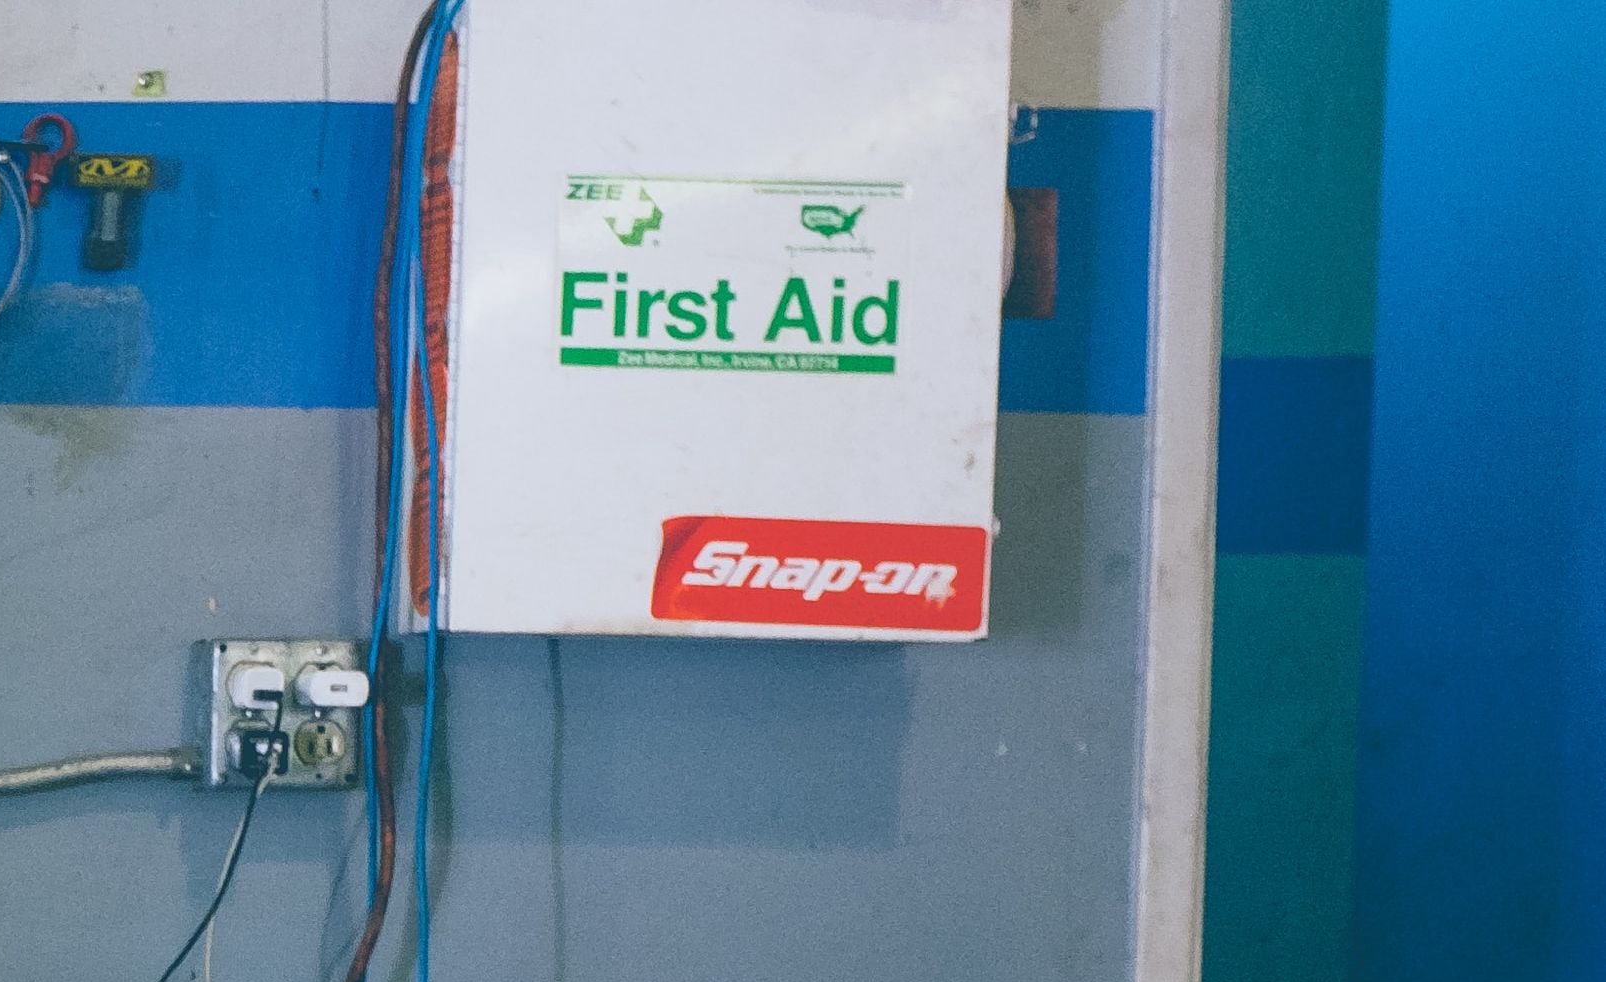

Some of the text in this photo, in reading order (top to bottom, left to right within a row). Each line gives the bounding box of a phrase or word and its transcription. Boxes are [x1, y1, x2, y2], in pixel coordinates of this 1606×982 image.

[566, 184, 623, 200] ZEE
[560, 271, 901, 346] First Aid
[682, 540, 958, 602] Snap-on
